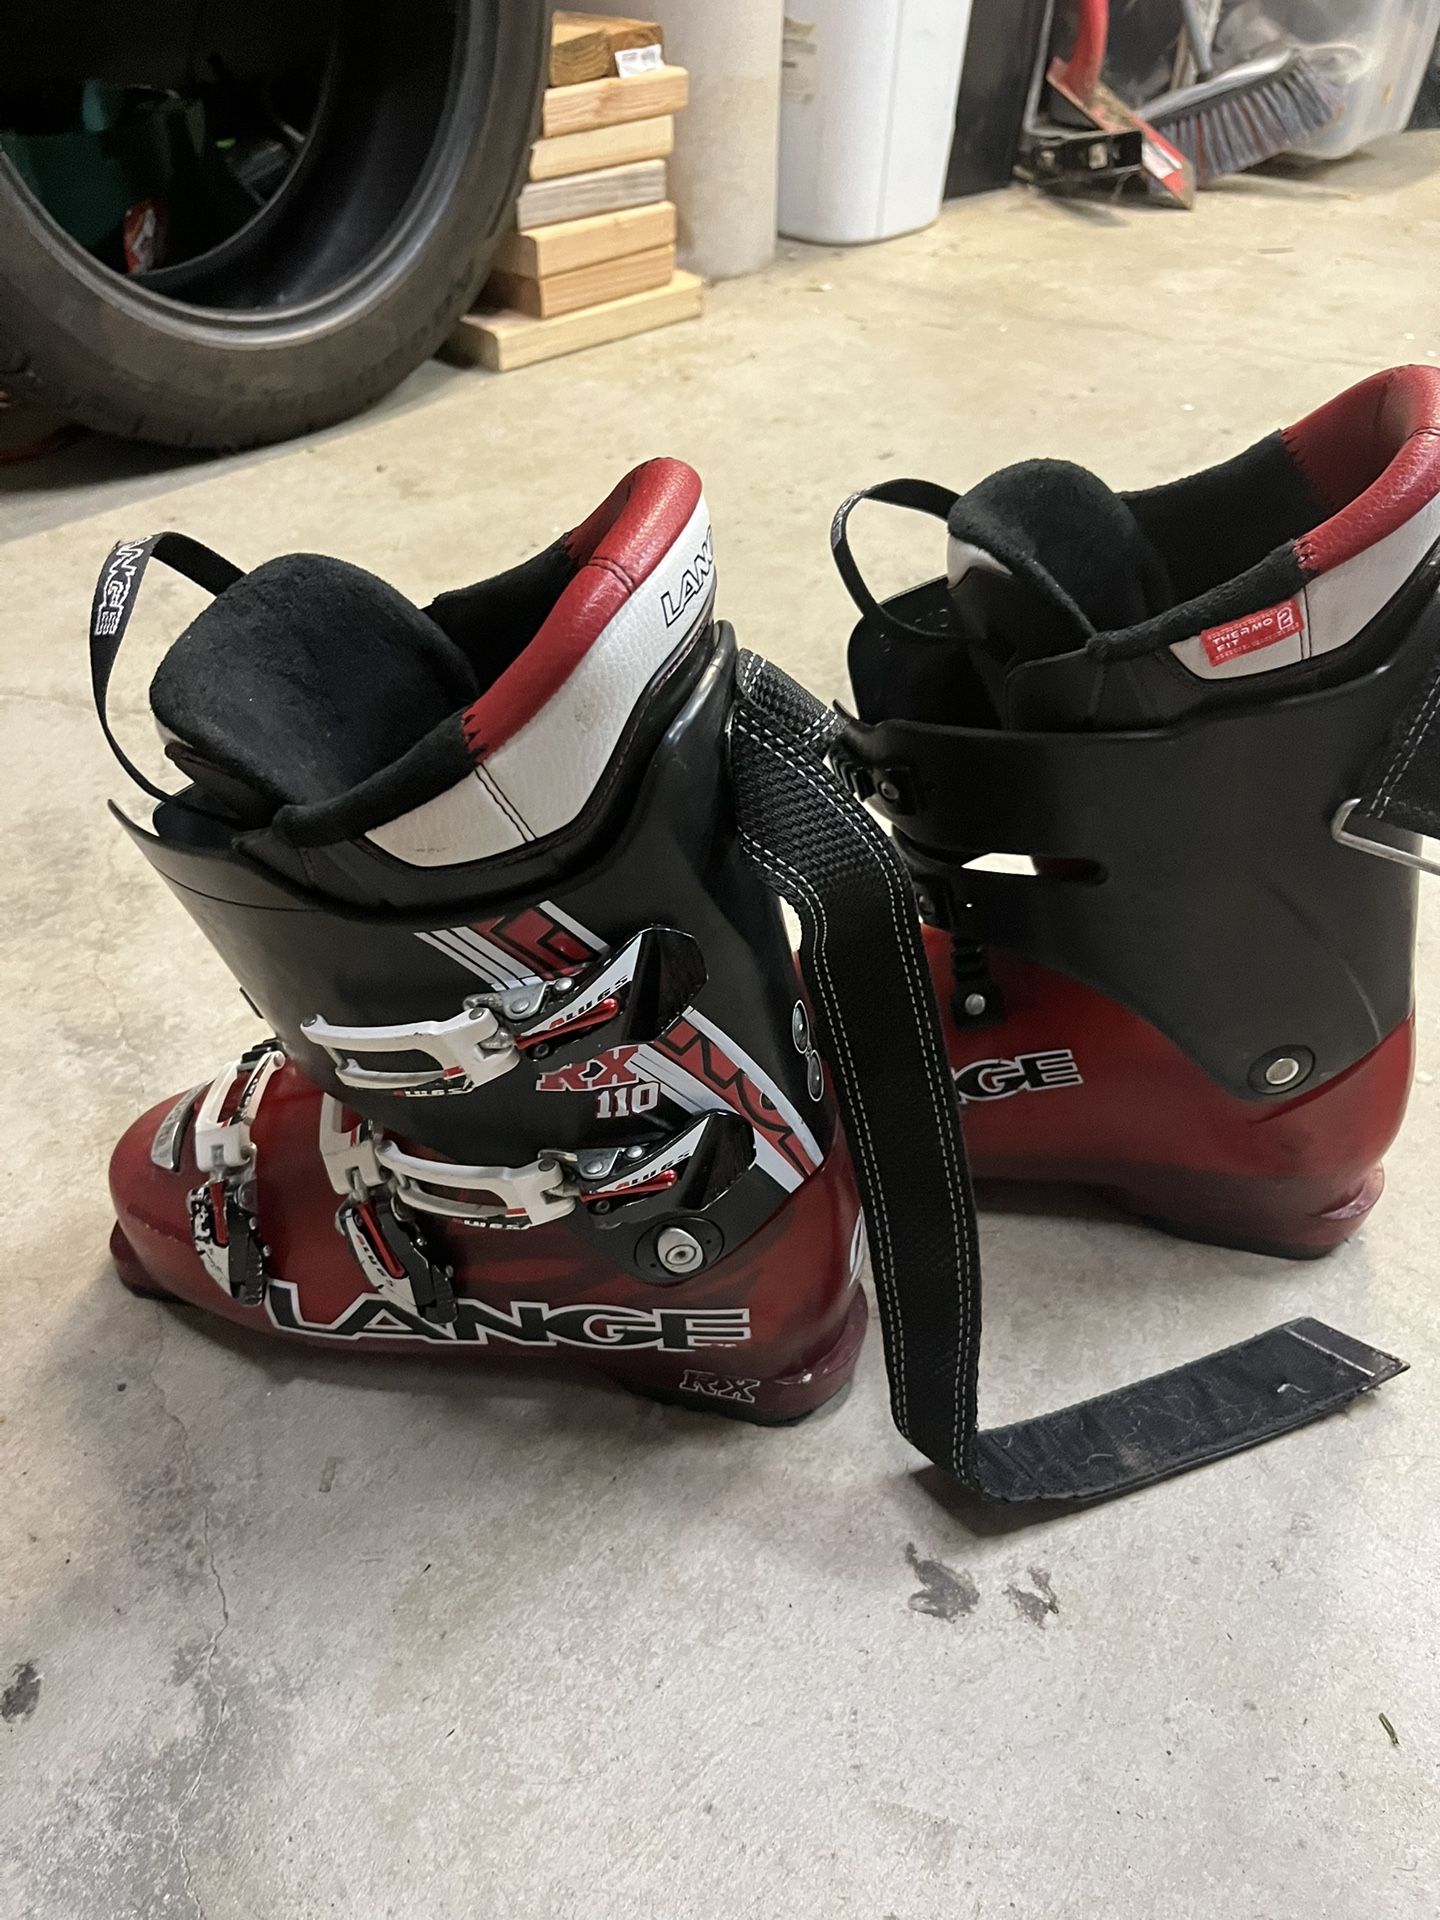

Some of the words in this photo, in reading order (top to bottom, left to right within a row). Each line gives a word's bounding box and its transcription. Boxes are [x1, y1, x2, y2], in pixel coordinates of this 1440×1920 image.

[1212, 618, 1273, 645] THERMO
[1216, 639, 1239, 653] FIT
[536, 1045, 640, 1092] RX
[951, 1048, 1084, 1105] GE
[596, 1080, 661, 1119] 110
[264, 1277, 752, 1352] LANGE
[679, 1369, 761, 1403] RX
